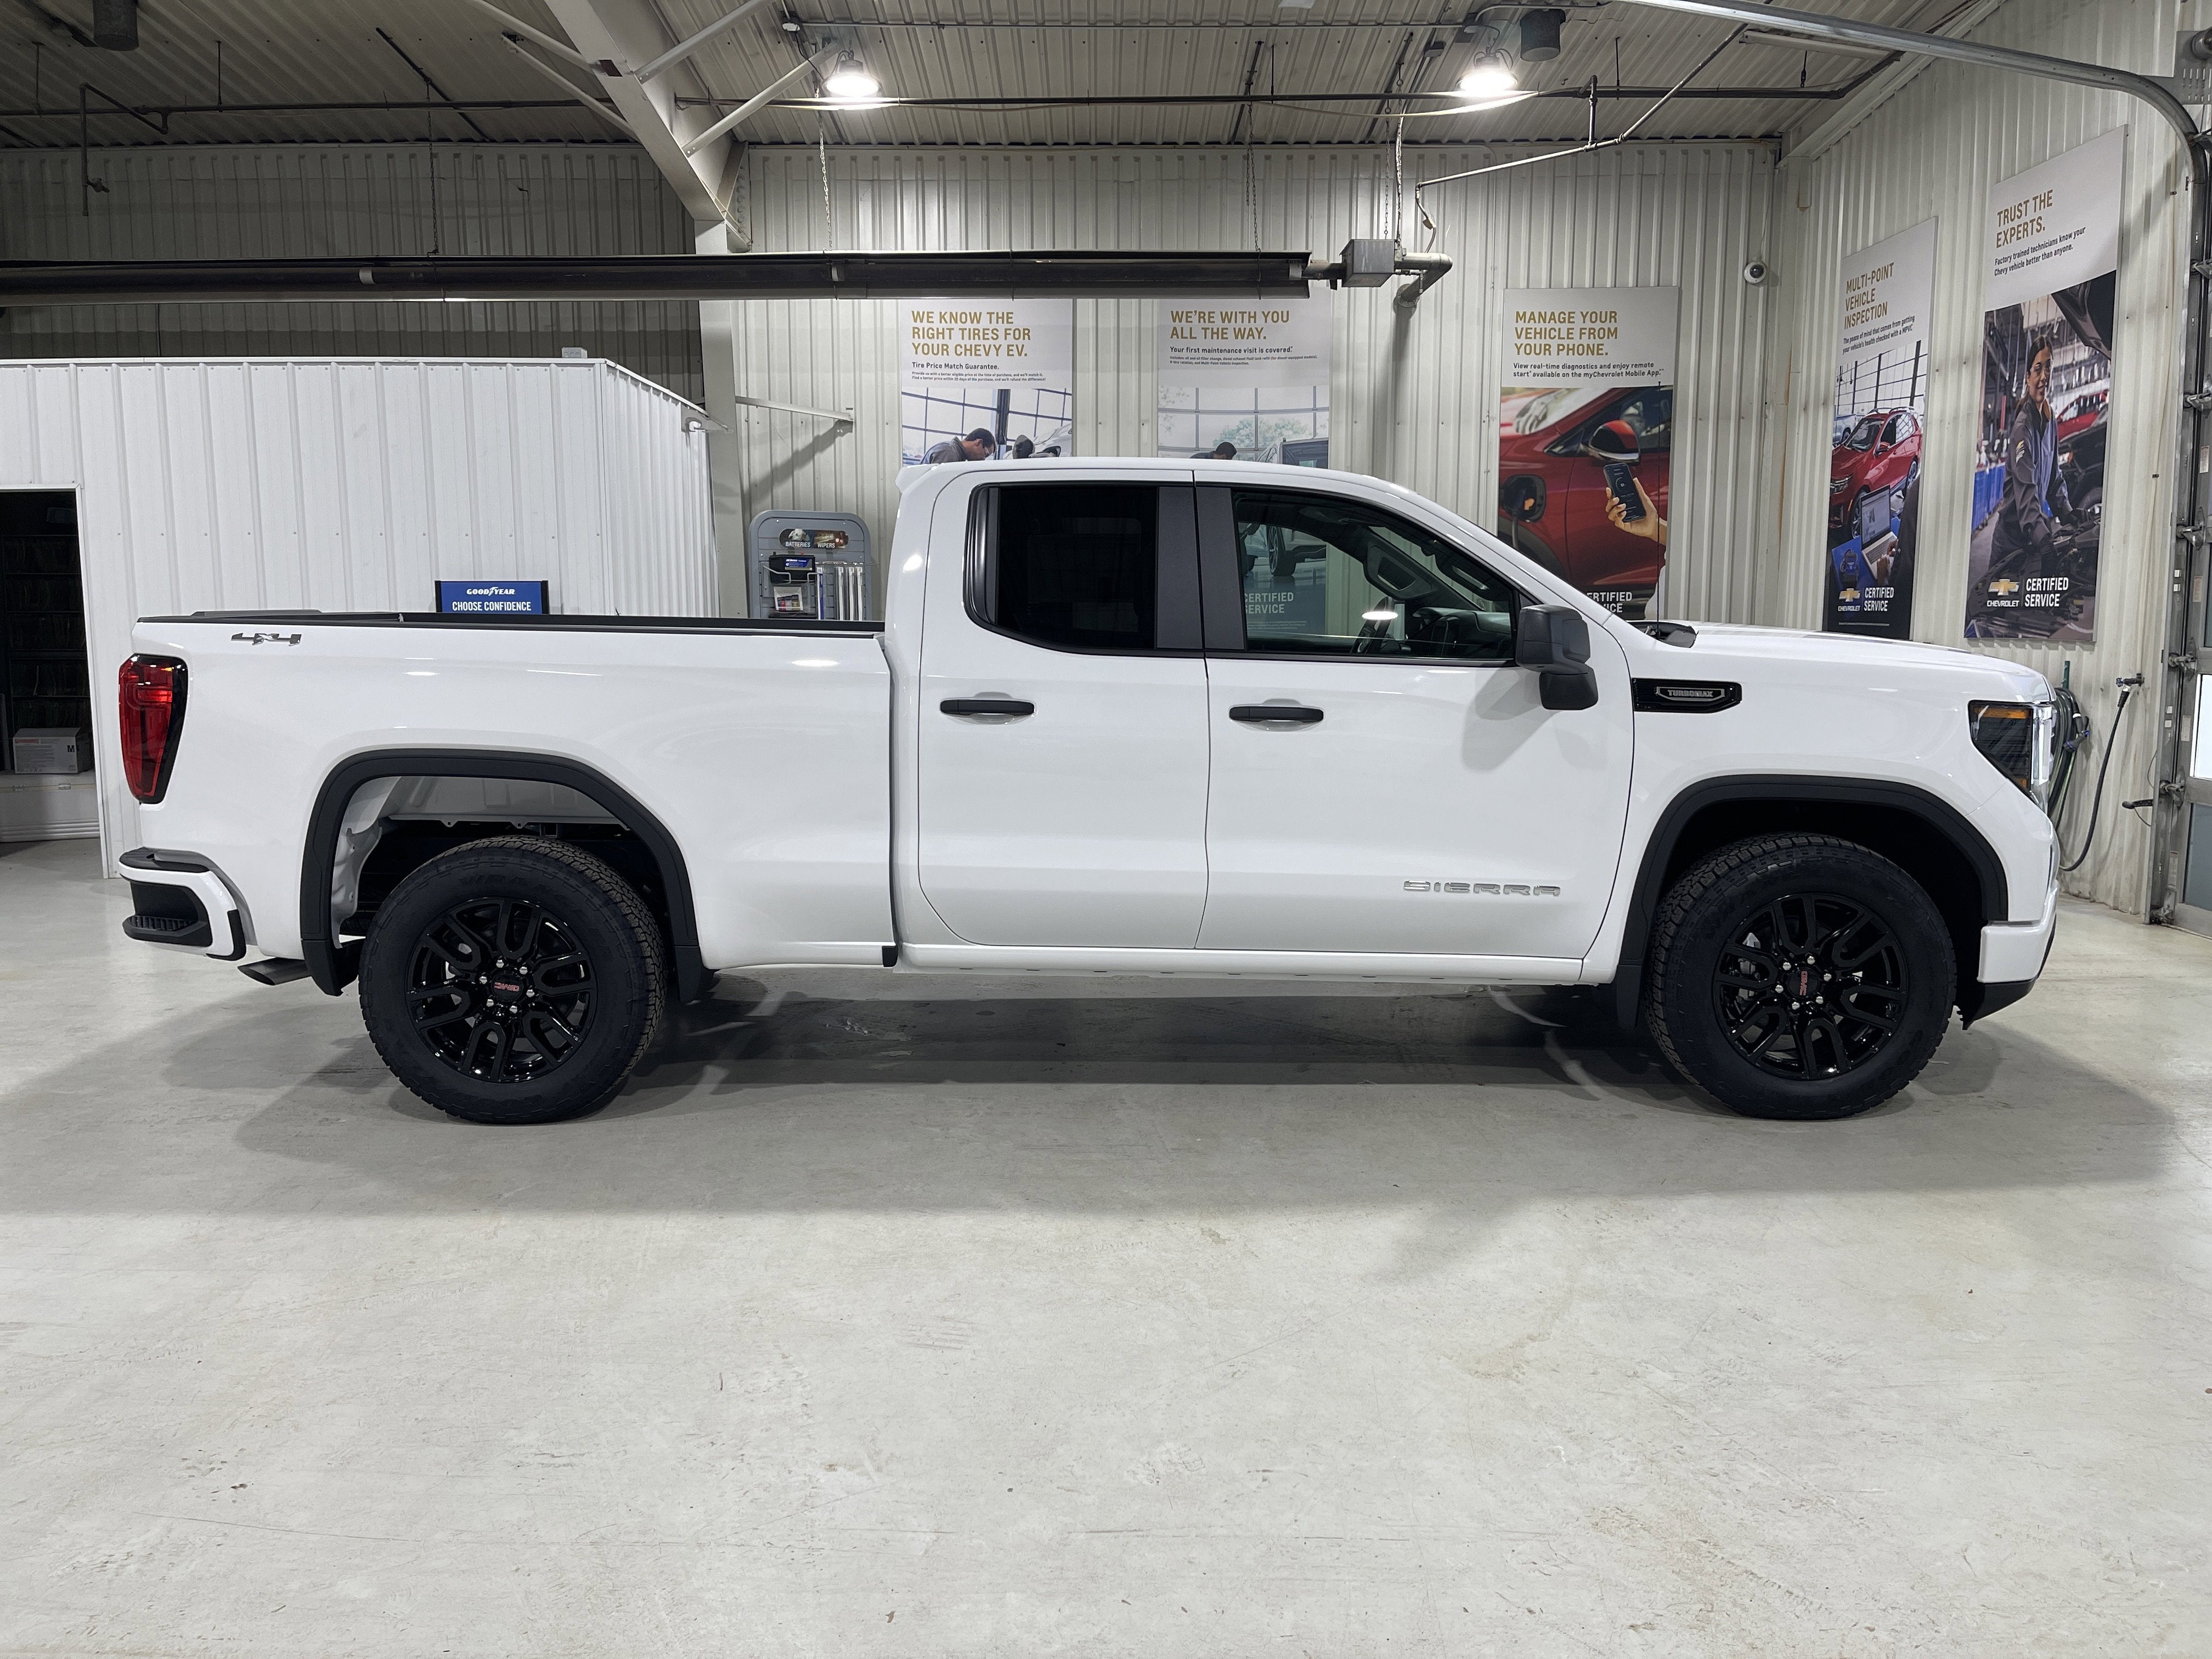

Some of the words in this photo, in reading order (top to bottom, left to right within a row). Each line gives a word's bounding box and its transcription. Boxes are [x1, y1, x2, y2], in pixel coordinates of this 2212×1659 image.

[1997, 199, 2029, 227] TRUST
[2033, 189, 2053, 213] THE
[1996, 216, 2045, 249] EXPERTS.
[1995, 255, 2012, 266] Factory
[2013, 247, 2030, 259] trained
[2030, 238, 2058, 253] technicians
[2059, 232, 2073, 242] know
[2073, 227, 2086, 240] your
[1994, 267, 2008, 276] Chevy
[2009, 260, 2025, 272] vehicle
[2025, 255, 2041, 266] better
[2041, 250, 2053, 261] than
[2053, 244, 2073, 256] anyone.
[1846, 262, 1894, 294] MULTI-POINT
[1846, 288, 1876, 312] VEHICLE
[911, 311, 934, 324] WE
[939, 312, 982, 324] KNOW
[987, 312, 1014, 324] THE
[1171, 311, 1215, 324] WE'RE
[1220, 311, 1256, 324] WITH
[1262, 311, 1289, 323] YOU
[1515, 311, 1576, 324] MANAGE
[1580, 311, 1618, 324] YOUR
[1844, 301, 1887, 329] INSPECTION
[912, 326, 954, 340] RIGHT
[959, 328, 999, 341] TIRES
[1004, 328, 1031, 341] FOR
[1170, 326, 1197, 339] ALL
[1201, 327, 1228, 340] THE
[1234, 327, 1267, 340] WAY.
[1515, 327, 1575, 340] VEHICLE
[1579, 327, 1618, 340] FROM
[912, 342, 949, 356] YOUR
[954, 343, 1002, 357] CHEVY
[1007, 344, 1028, 357] EV.
[1514, 343, 1551, 356] YOUR
[1556, 343, 1609, 356] PHONE.
[1561, 363, 1598, 371] diagnostics
[1612, 362, 1629, 370] enjoy
[1583, 370, 1623, 379] myChevrolet
[2026, 577, 2069, 591] CERTIFIED
[466, 587, 515, 596] GOODYEAR
[1587, 591, 1632, 602] RTIFIED
[1865, 587, 1894, 599] CERTIFIED
[452, 601, 483, 611] CHOOSE
[484, 601, 532, 611] CONFIDENCE
[1864, 600, 1888, 612] SERVICE
[2024, 594, 2061, 607] SERVICE
[1403, 880, 1561, 896] SIERRA
